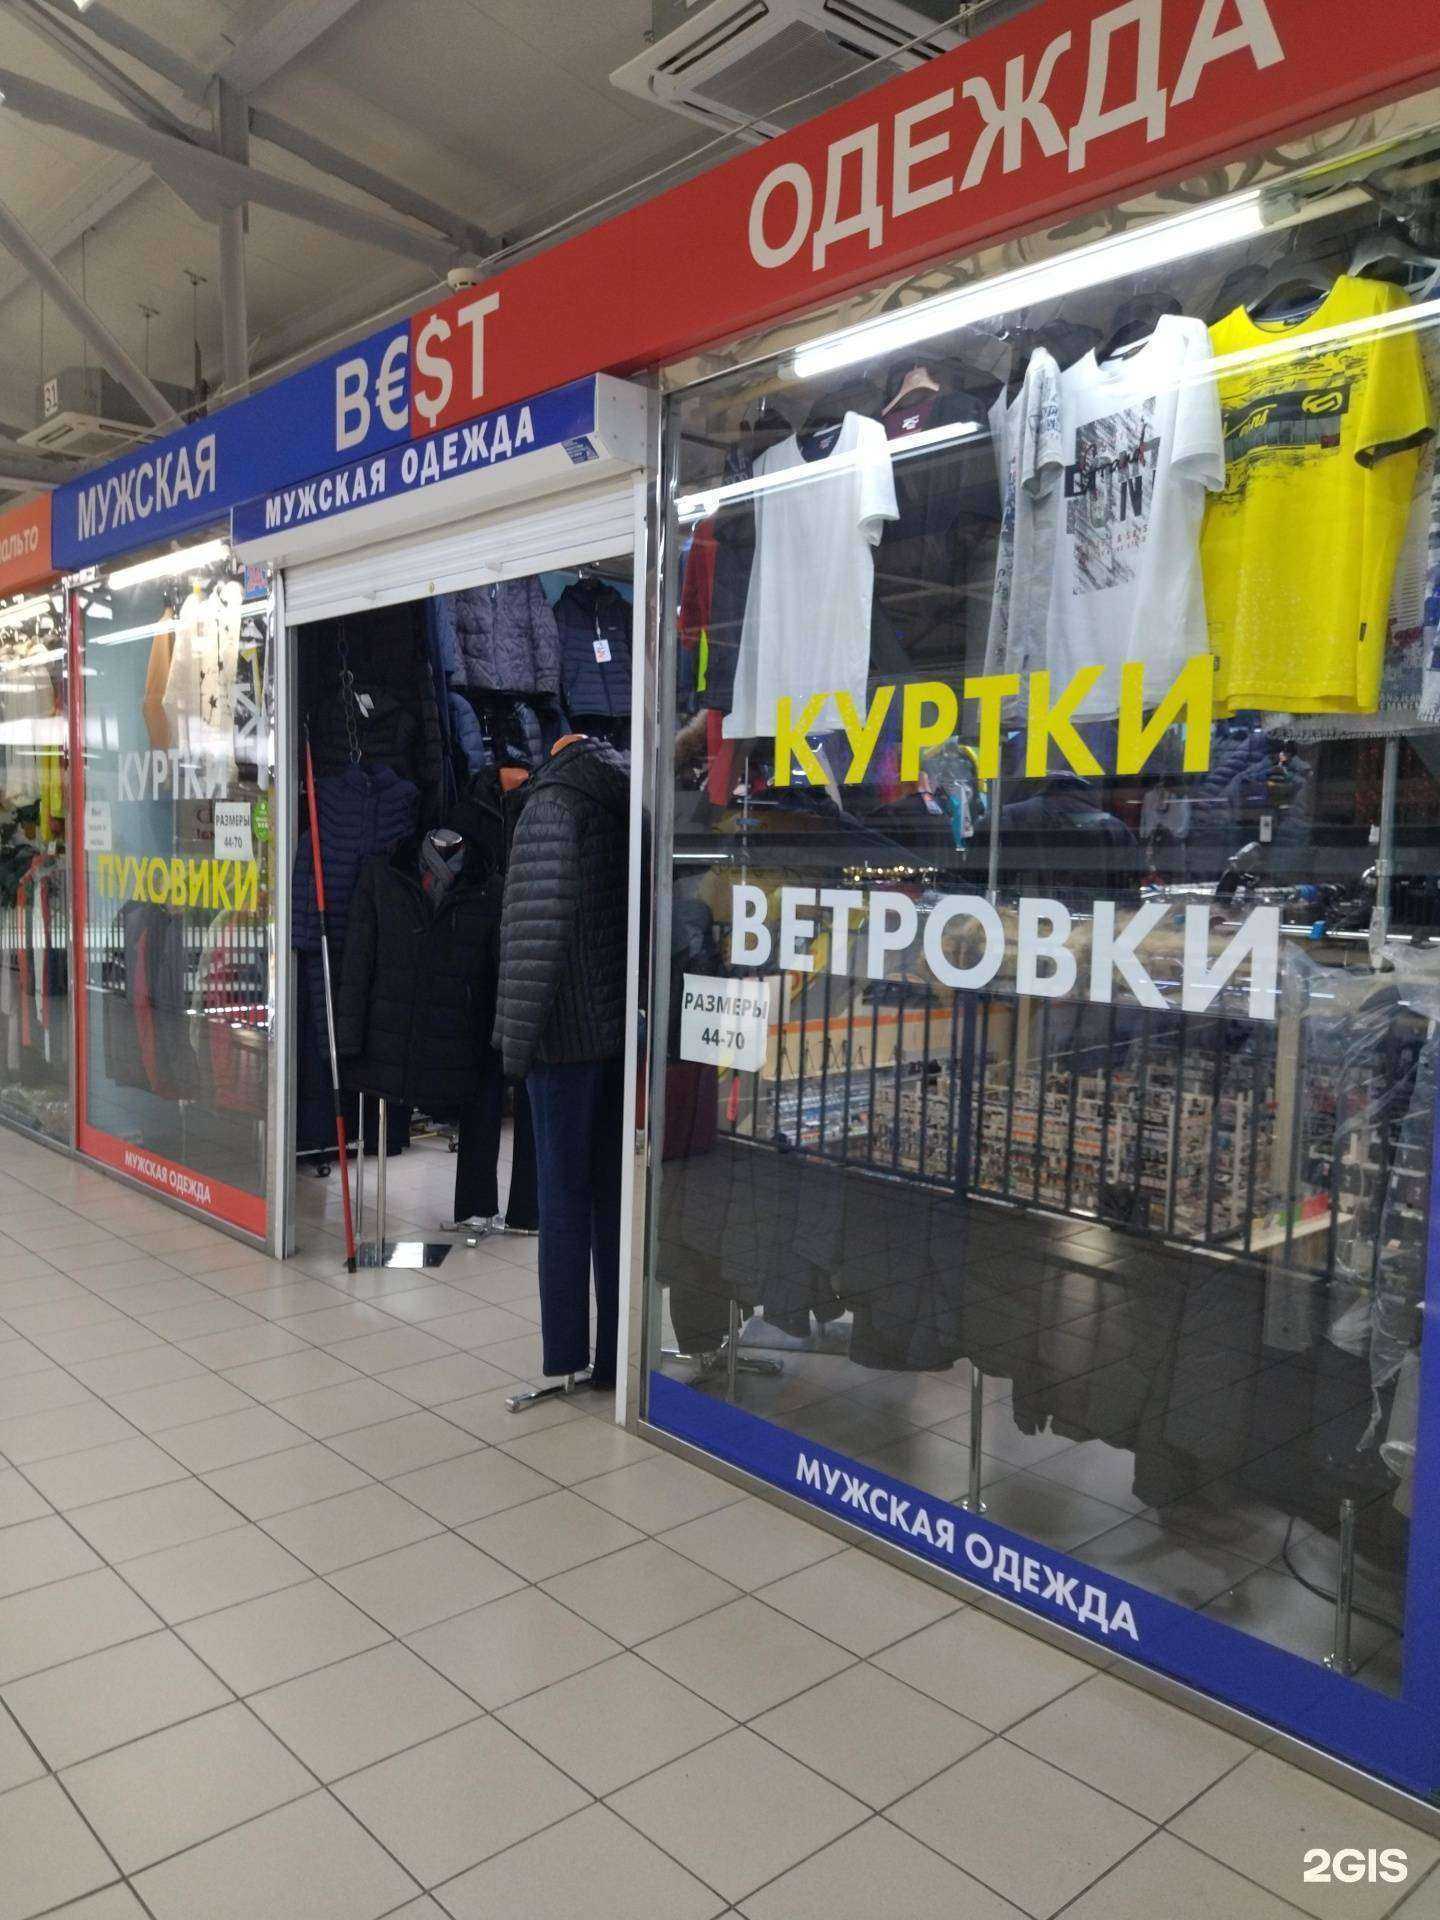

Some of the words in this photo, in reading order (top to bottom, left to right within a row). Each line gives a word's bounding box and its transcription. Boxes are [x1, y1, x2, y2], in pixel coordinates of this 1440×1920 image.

[748, 0, 1285, 270] ОДЕЖДА
[77, 434, 217, 541] МУЖСКАЯ
[265, 458, 386, 529] МУЖСКАЯ
[401, 406, 535, 493] ОДЕЖДА
[0, 526, 38, 566] альто
[774, 654, 1214, 787] КУРТКИ
[117, 749, 228, 801] КУРТКИ
[215, 812, 250, 827] РАЗМЕРЫ
[224, 837, 242, 849] 44-70
[97, 854, 258, 912] ПУХОВИКИ
[731, 884, 1281, 1021] ВЕТРОВКИ
[684, 992, 768, 1020] РАЗМЕРЫ
[701, 1027, 746, 1050] 44-70
[124, 1150, 168, 1183] МУЖСКАЯ
[169, 1170, 211, 1204] ОДЕЖДА
[796, 1453, 955, 1554] МУЖСКАЯ
[964, 1532, 1140, 1641] ОДЕЖДА
